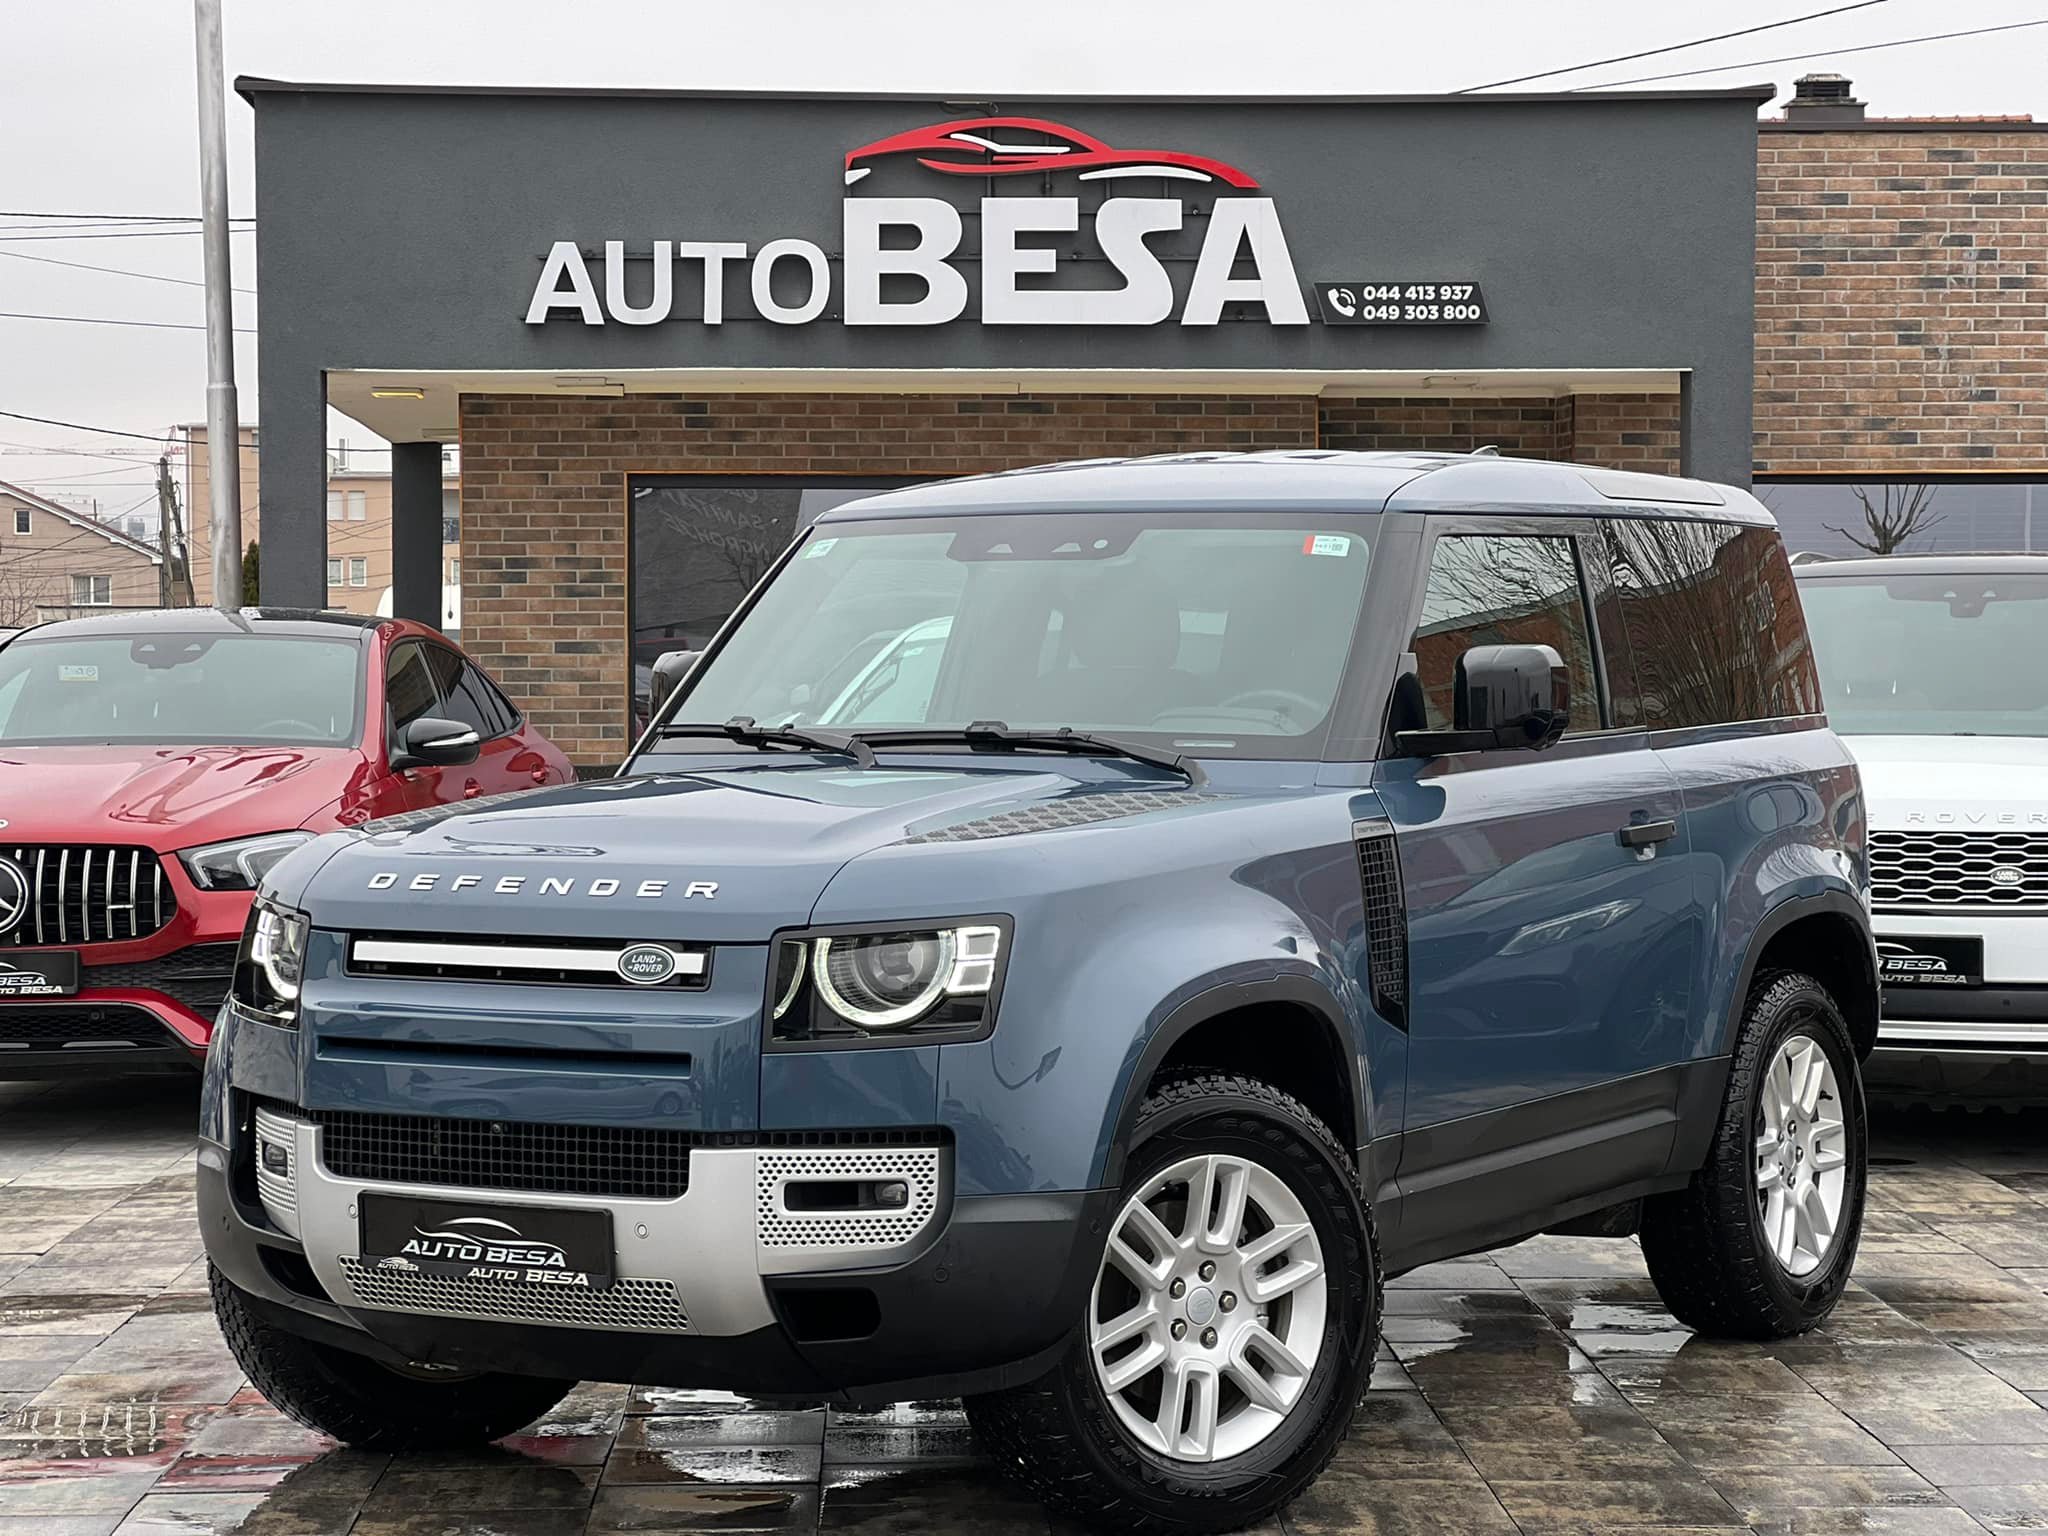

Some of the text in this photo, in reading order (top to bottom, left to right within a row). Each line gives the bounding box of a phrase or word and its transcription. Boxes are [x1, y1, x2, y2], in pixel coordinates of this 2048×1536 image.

[525, 197, 1310, 325] AUTO BESA
[1363, 286, 1473, 300] 044 413 937
[1363, 305, 1480, 320] 049 303 800
[1906, 812, 2048, 824] ROVER
[367, 872, 720, 899] DEFENDER
[1887, 960, 1947, 971] BESA
[1919, 974, 1967, 984] BESA
[20, 985, 63, 994] BESA
[401, 1239, 567, 1268] AUTO BESA
[467, 1267, 589, 1287] AUTO BESA
